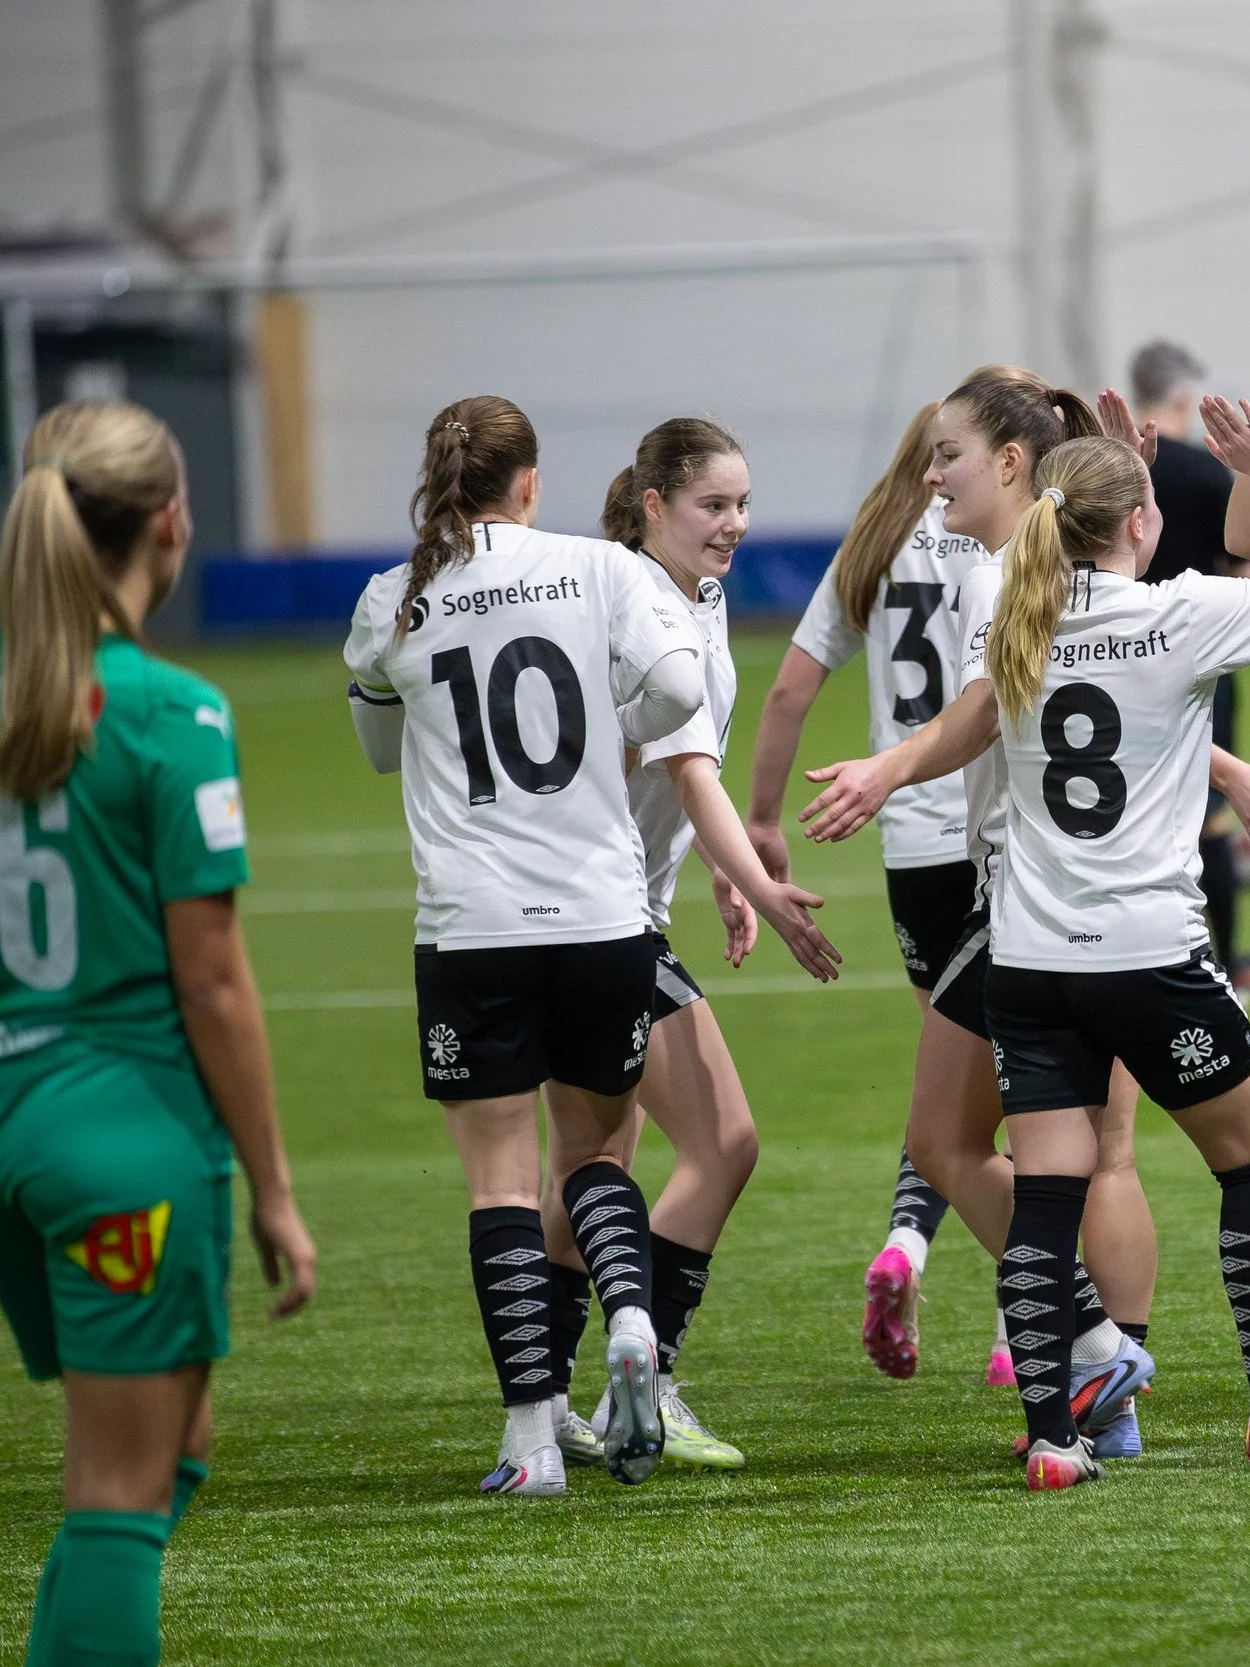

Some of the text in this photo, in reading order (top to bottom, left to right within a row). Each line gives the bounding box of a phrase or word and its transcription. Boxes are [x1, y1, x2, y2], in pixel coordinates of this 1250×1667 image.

[443, 576, 581, 616] Sognekraft
[884, 581, 960, 727] 3
[1048, 630, 1170, 668] ognekraft
[431, 635, 587, 807] 10
[1041, 682, 1127, 840] 8
[522, 906, 560, 916] umbro
[1068, 932, 1102, 944] umbro
[428, 1066, 470, 1080] mesta
[1178, 1054, 1231, 1084] mesta
